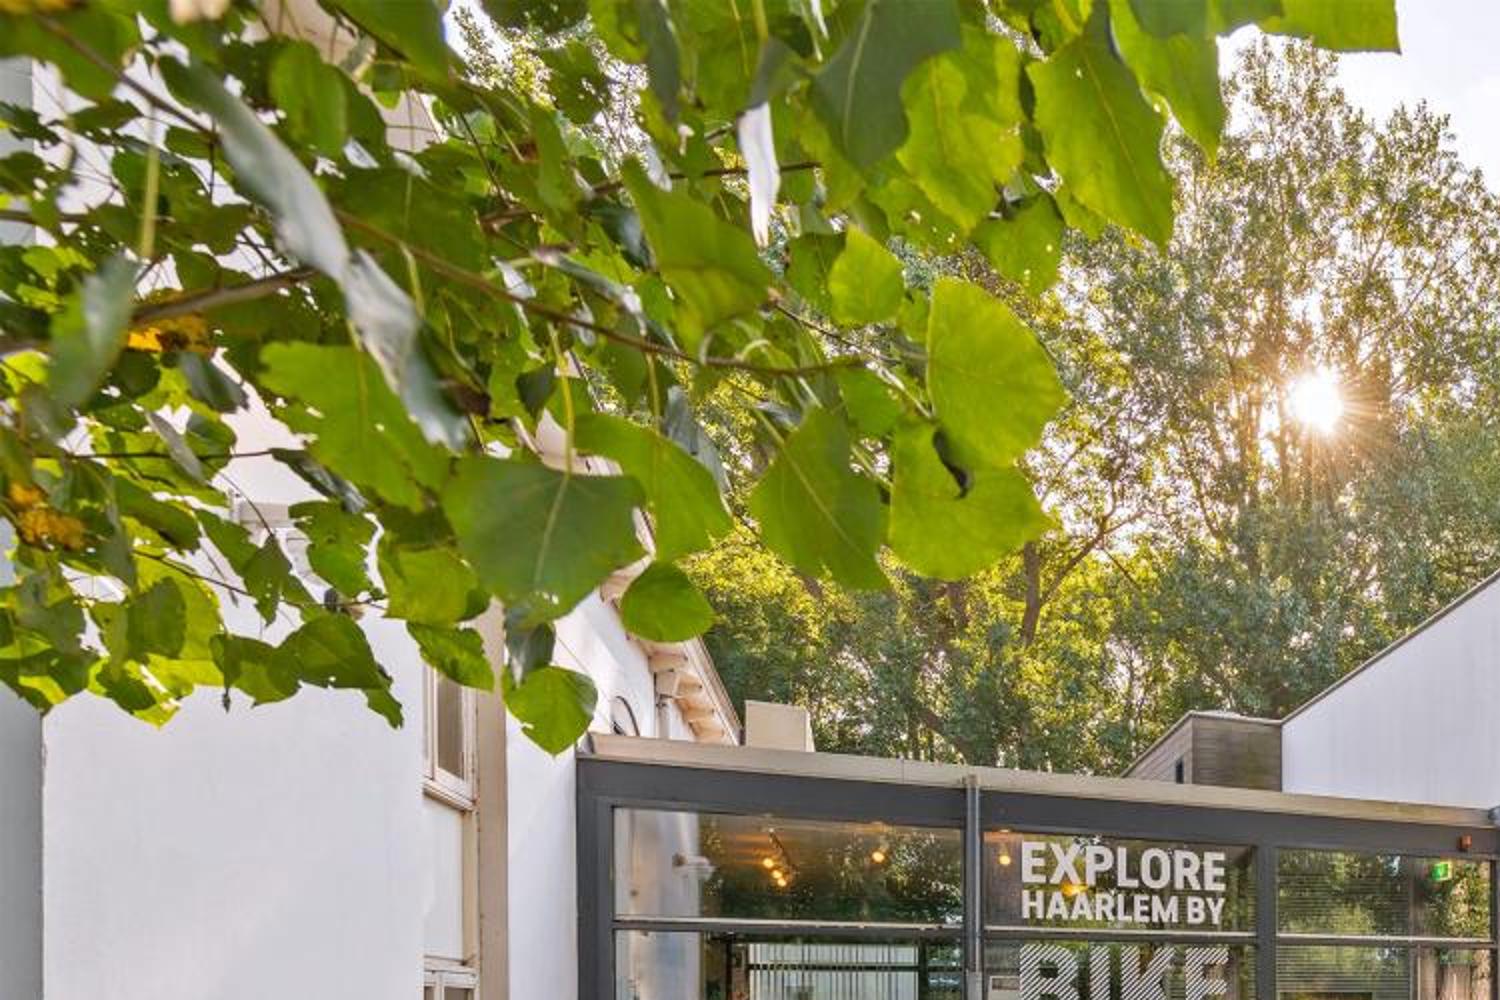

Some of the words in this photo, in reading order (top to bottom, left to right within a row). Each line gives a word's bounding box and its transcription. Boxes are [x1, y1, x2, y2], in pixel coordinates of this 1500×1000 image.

[1021, 839, 1226, 892] EXPLORE
[1022, 889, 1178, 923] HAARLEM
[1187, 895, 1226, 925] BY
